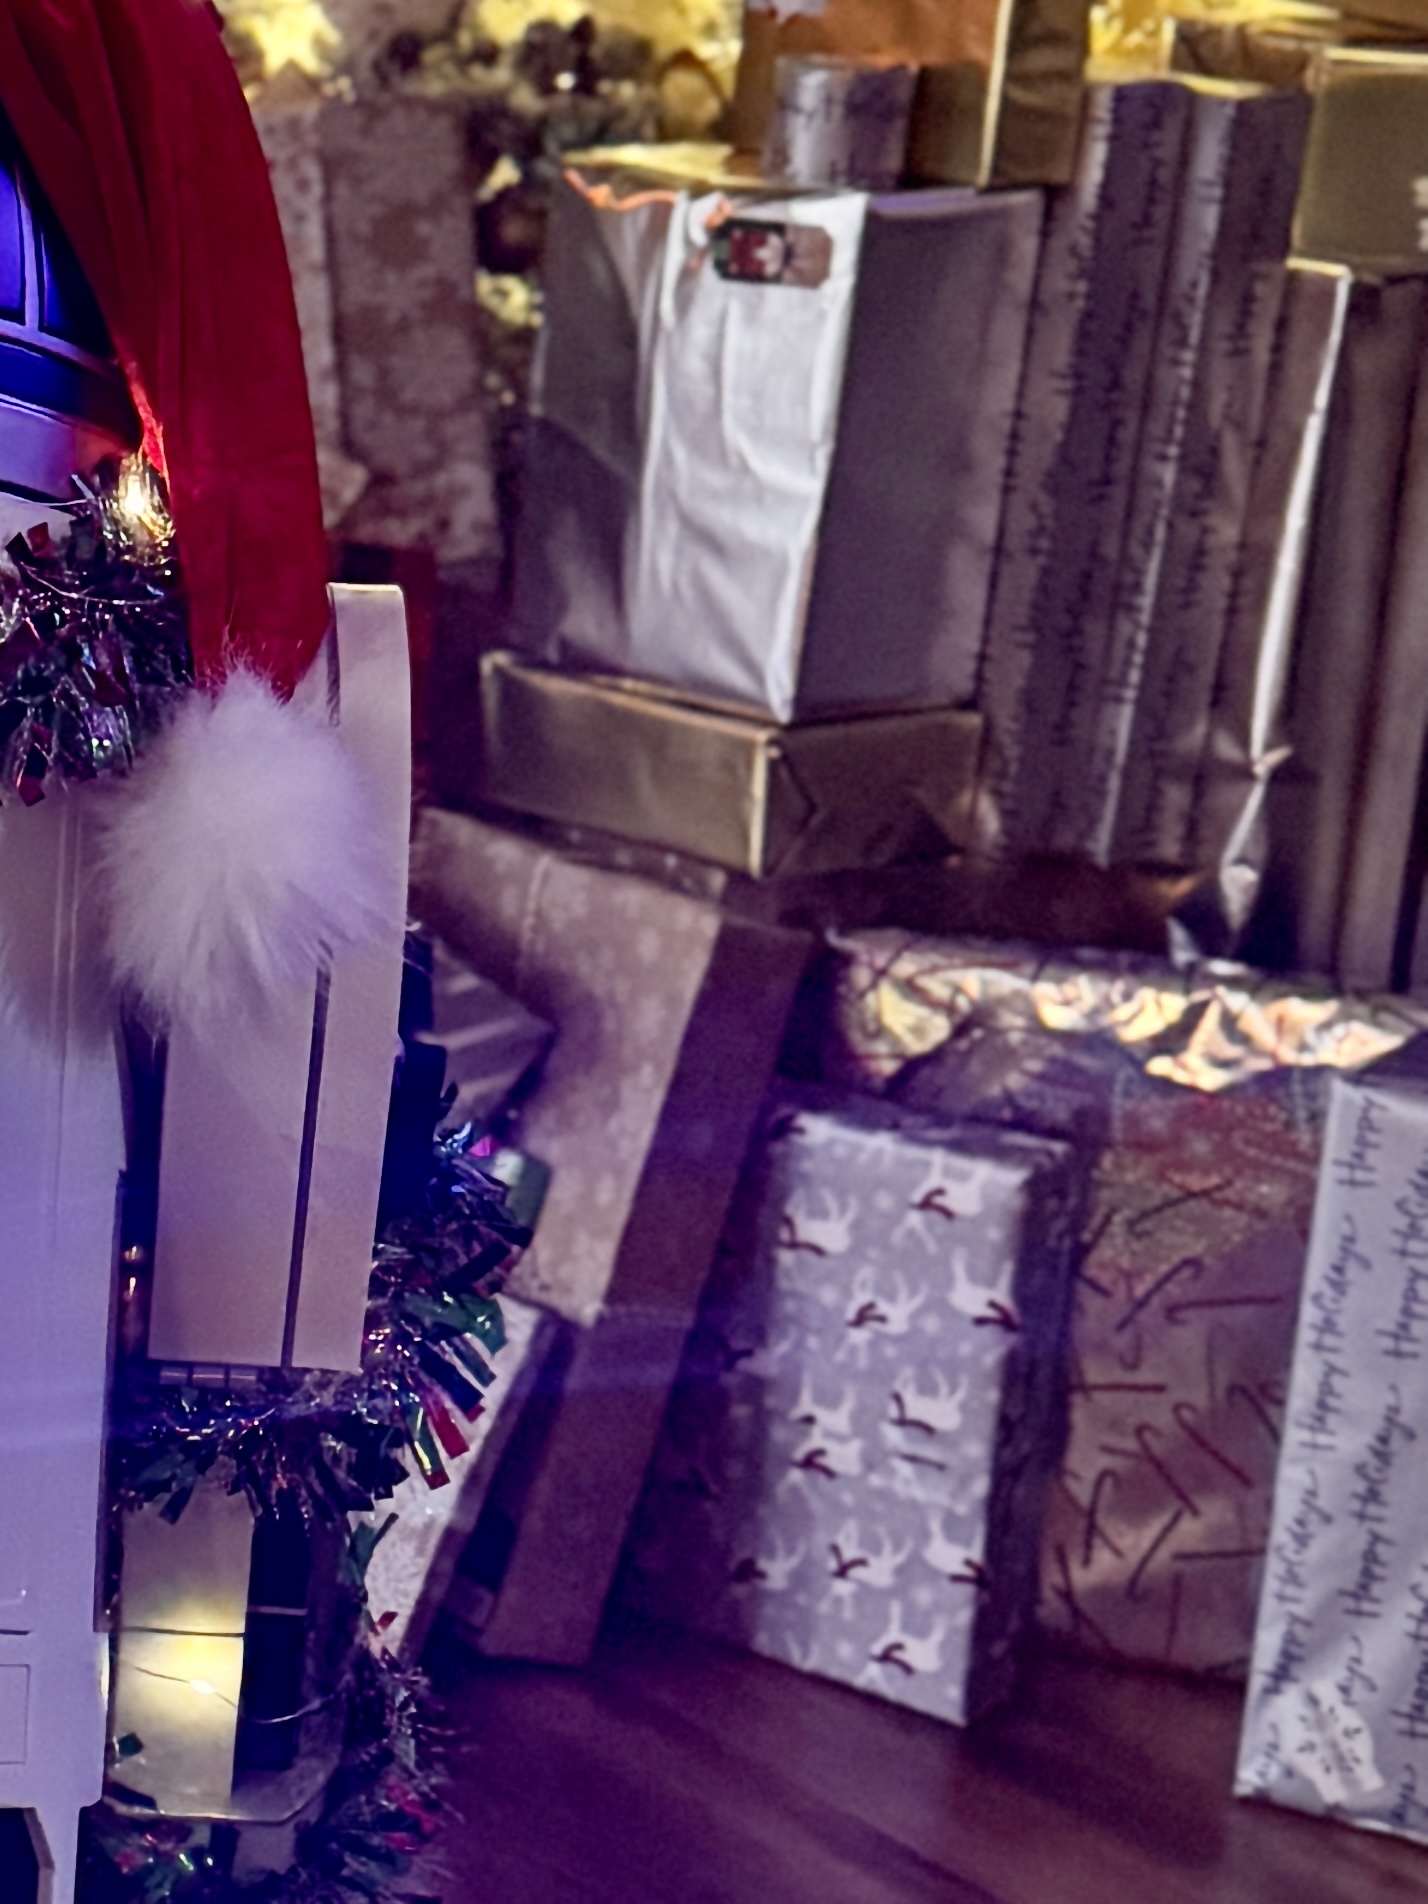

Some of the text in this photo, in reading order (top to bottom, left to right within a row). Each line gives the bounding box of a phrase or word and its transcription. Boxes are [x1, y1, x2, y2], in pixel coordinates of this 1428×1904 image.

[1331, 1094, 1389, 1189] Happy
[1293, 1359, 1350, 1452] Happy
[1337, 1527, 1397, 1619] Happy
